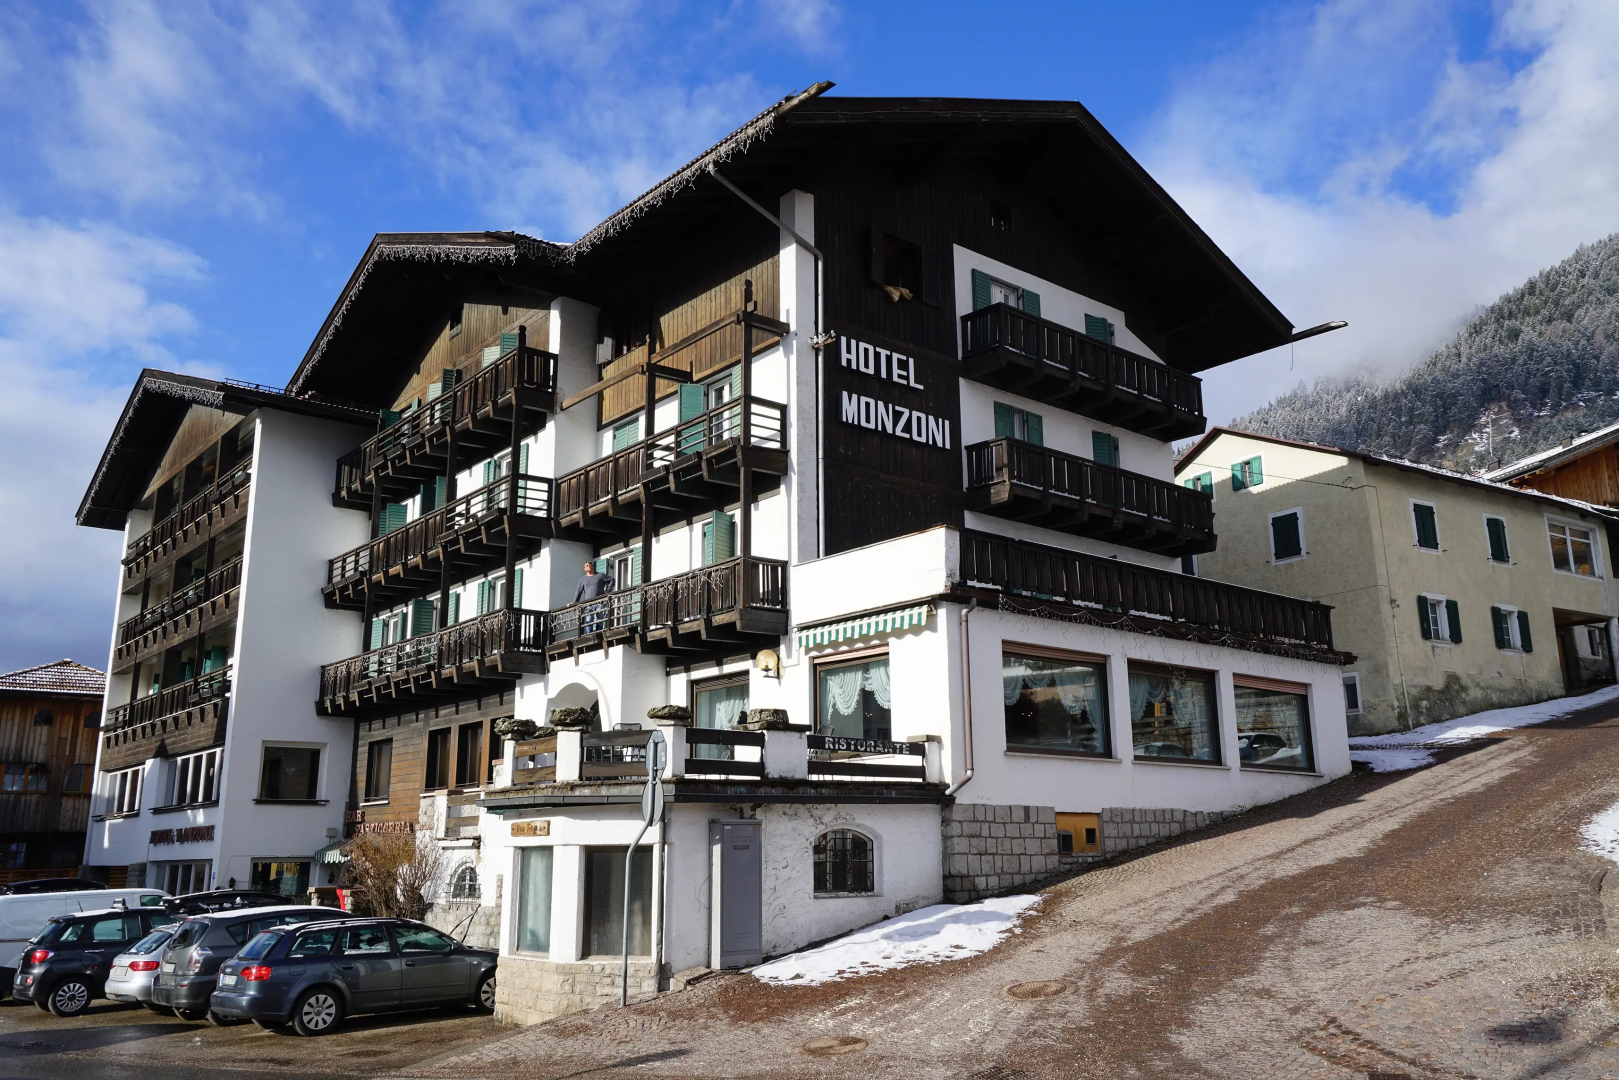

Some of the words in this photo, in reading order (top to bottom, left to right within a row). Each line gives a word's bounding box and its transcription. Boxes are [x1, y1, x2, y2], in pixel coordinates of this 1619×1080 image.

[840, 335, 924, 390] HOTEL
[842, 390, 951, 450] MONZONI
[825, 736, 910, 755] RISTORANTE
[346, 810, 363, 823] BAR
